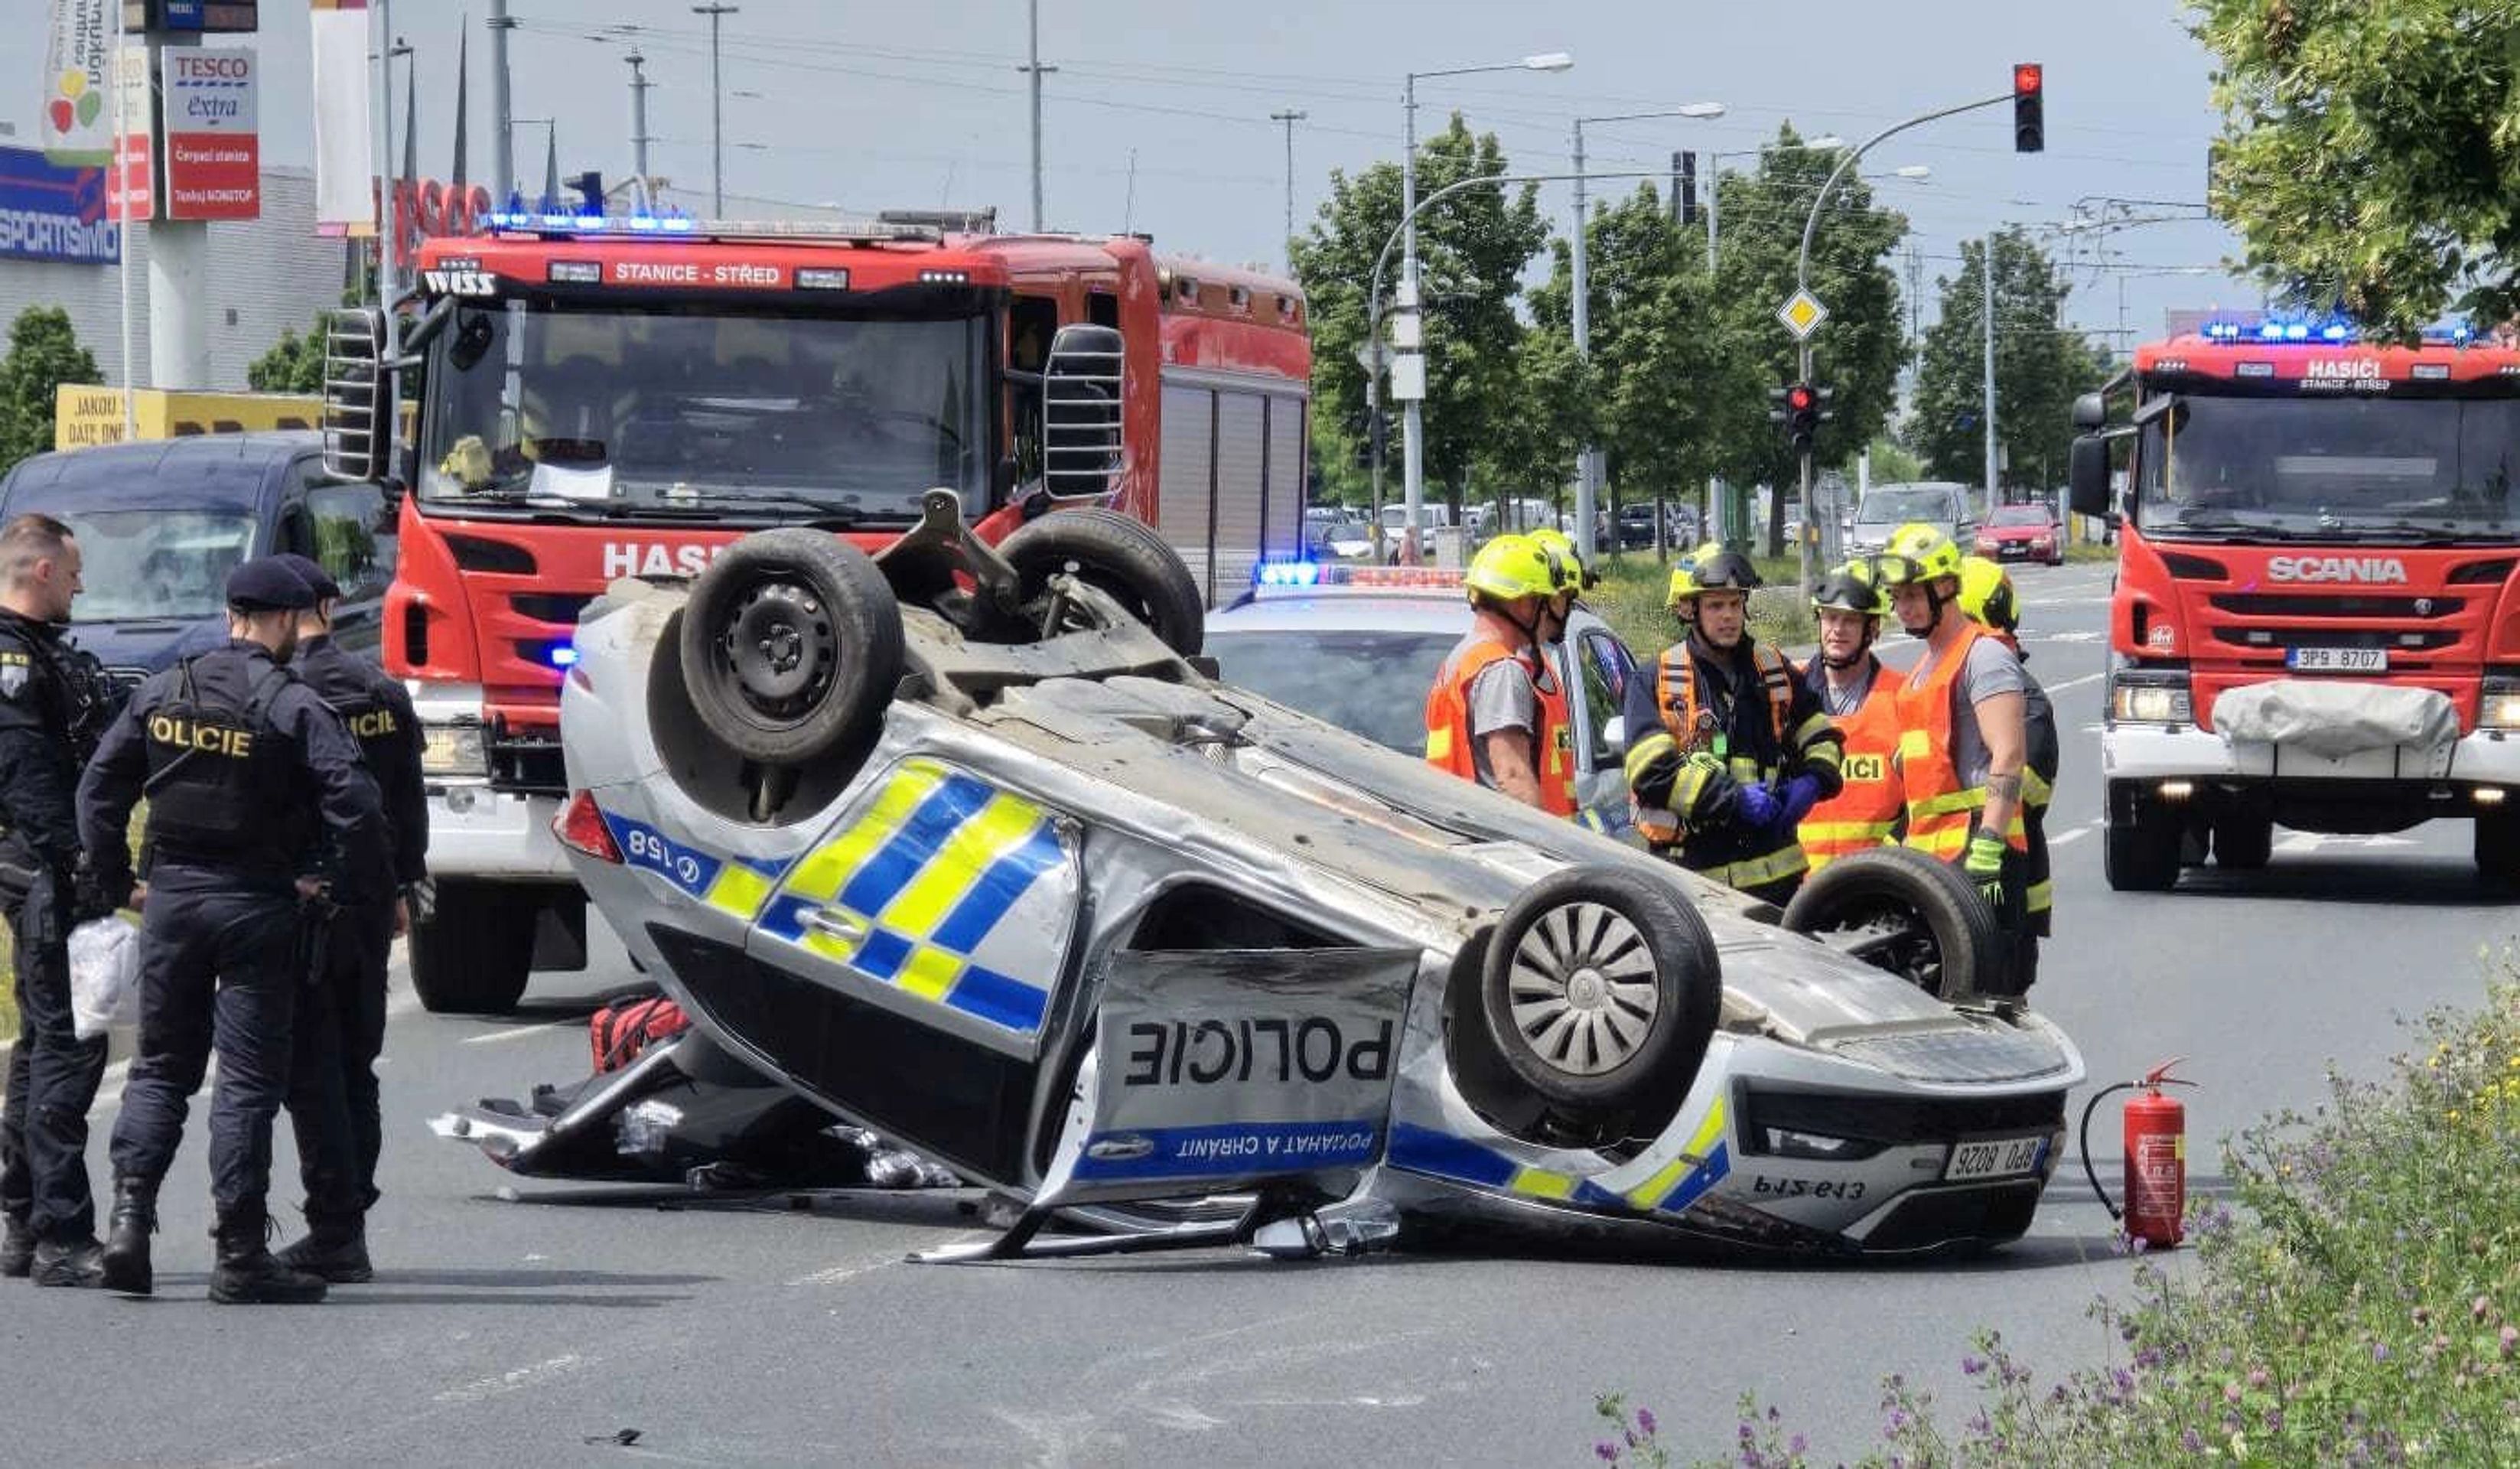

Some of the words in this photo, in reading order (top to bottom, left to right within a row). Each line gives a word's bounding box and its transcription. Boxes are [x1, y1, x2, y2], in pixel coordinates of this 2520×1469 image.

[176, 57, 248, 77] TESCO
[188, 95, 238, 117] extra
[207, 190, 252, 202] NONSTOP
[0, 208, 118, 259] SPORTISIMO
[616, 263, 698, 281] STANICE
[715, 264, 779, 283] STŘED
[2307, 357, 2381, 379] HASIČI
[75, 395, 116, 417] JAKOU
[604, 543, 724, 578] HAS
[2268, 556, 2408, 582] SCANIA
[2300, 650, 2330, 666] 3P9
[2341, 651, 2380, 667] 8707
[148, 715, 253, 757] OLICIE
[629, 830, 673, 868] 158
[1124, 1017, 1393, 1086] POLICIE
[1175, 1136, 1258, 1161] CHRÁNIT
[1266, 1136, 1281, 1155] A
